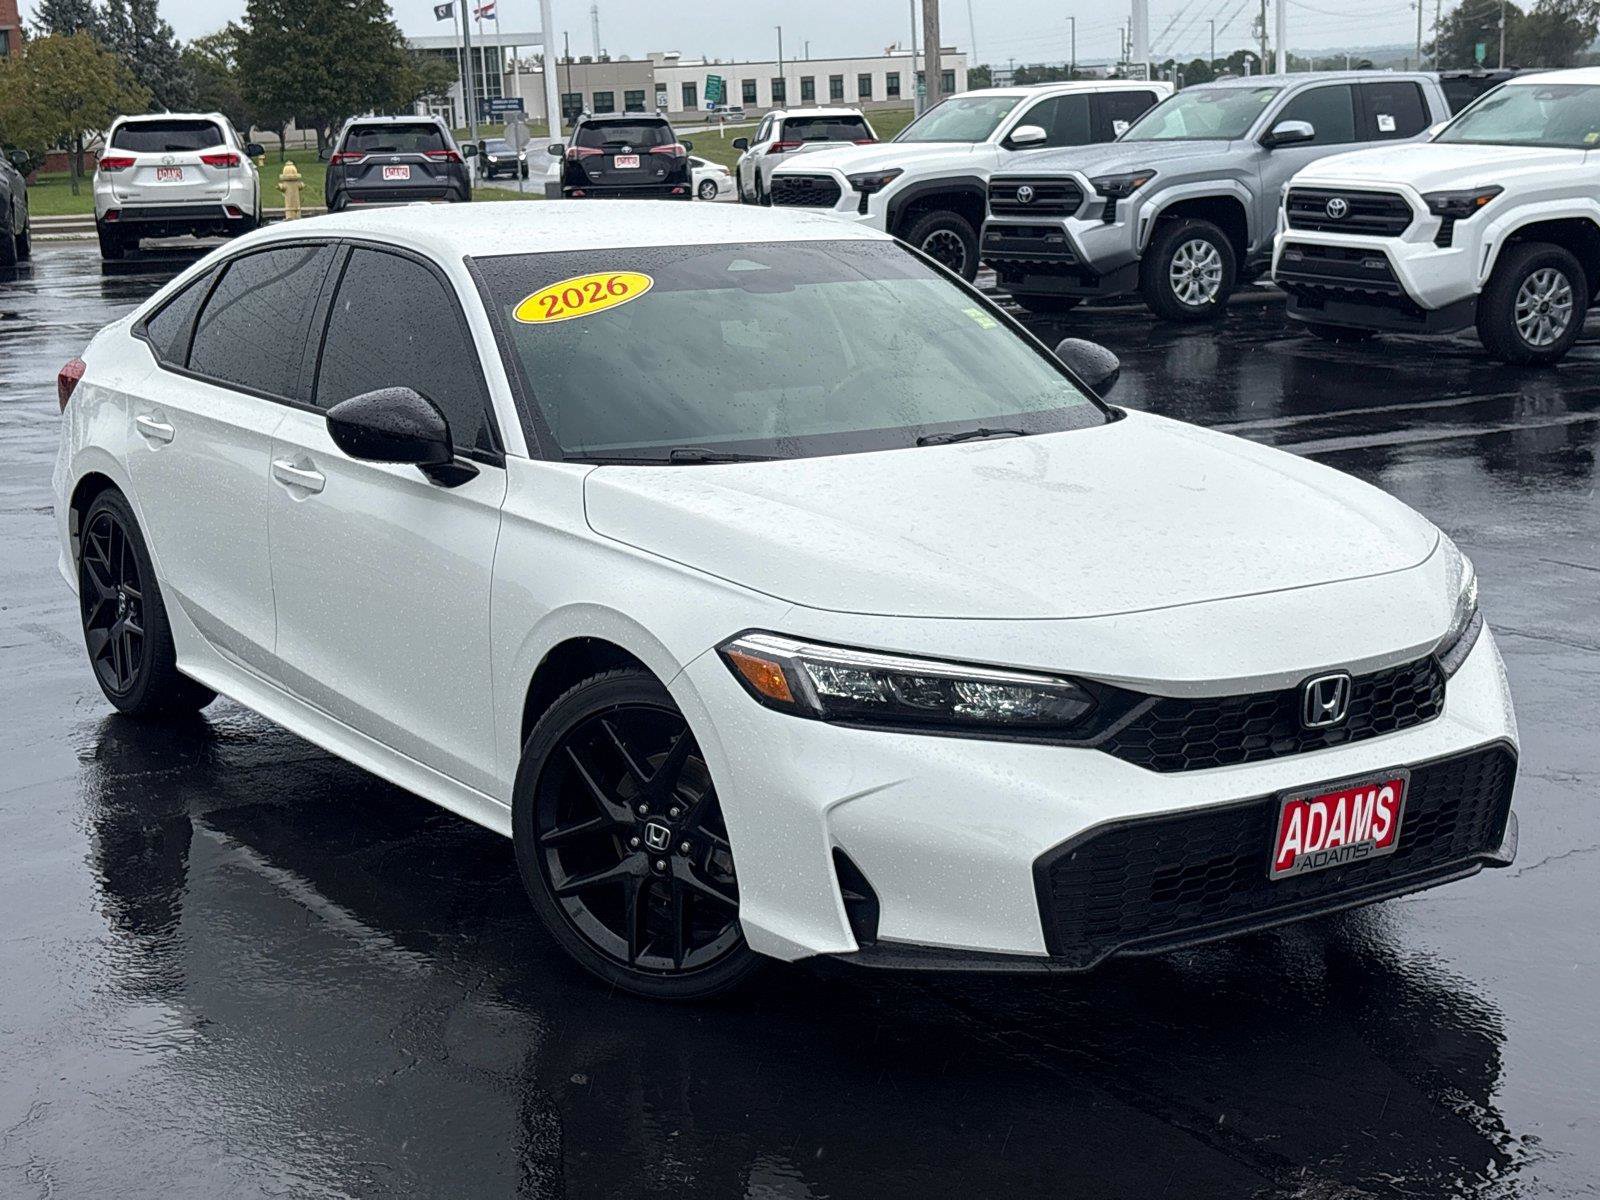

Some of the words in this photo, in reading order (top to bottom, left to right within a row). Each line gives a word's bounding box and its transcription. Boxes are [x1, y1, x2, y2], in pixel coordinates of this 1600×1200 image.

[158, 169, 182, 178] ADAMS
[538, 275, 628, 319] 2026
[1277, 786, 1394, 864] ADAMS
[1300, 843, 1369, 871] ADAMS
